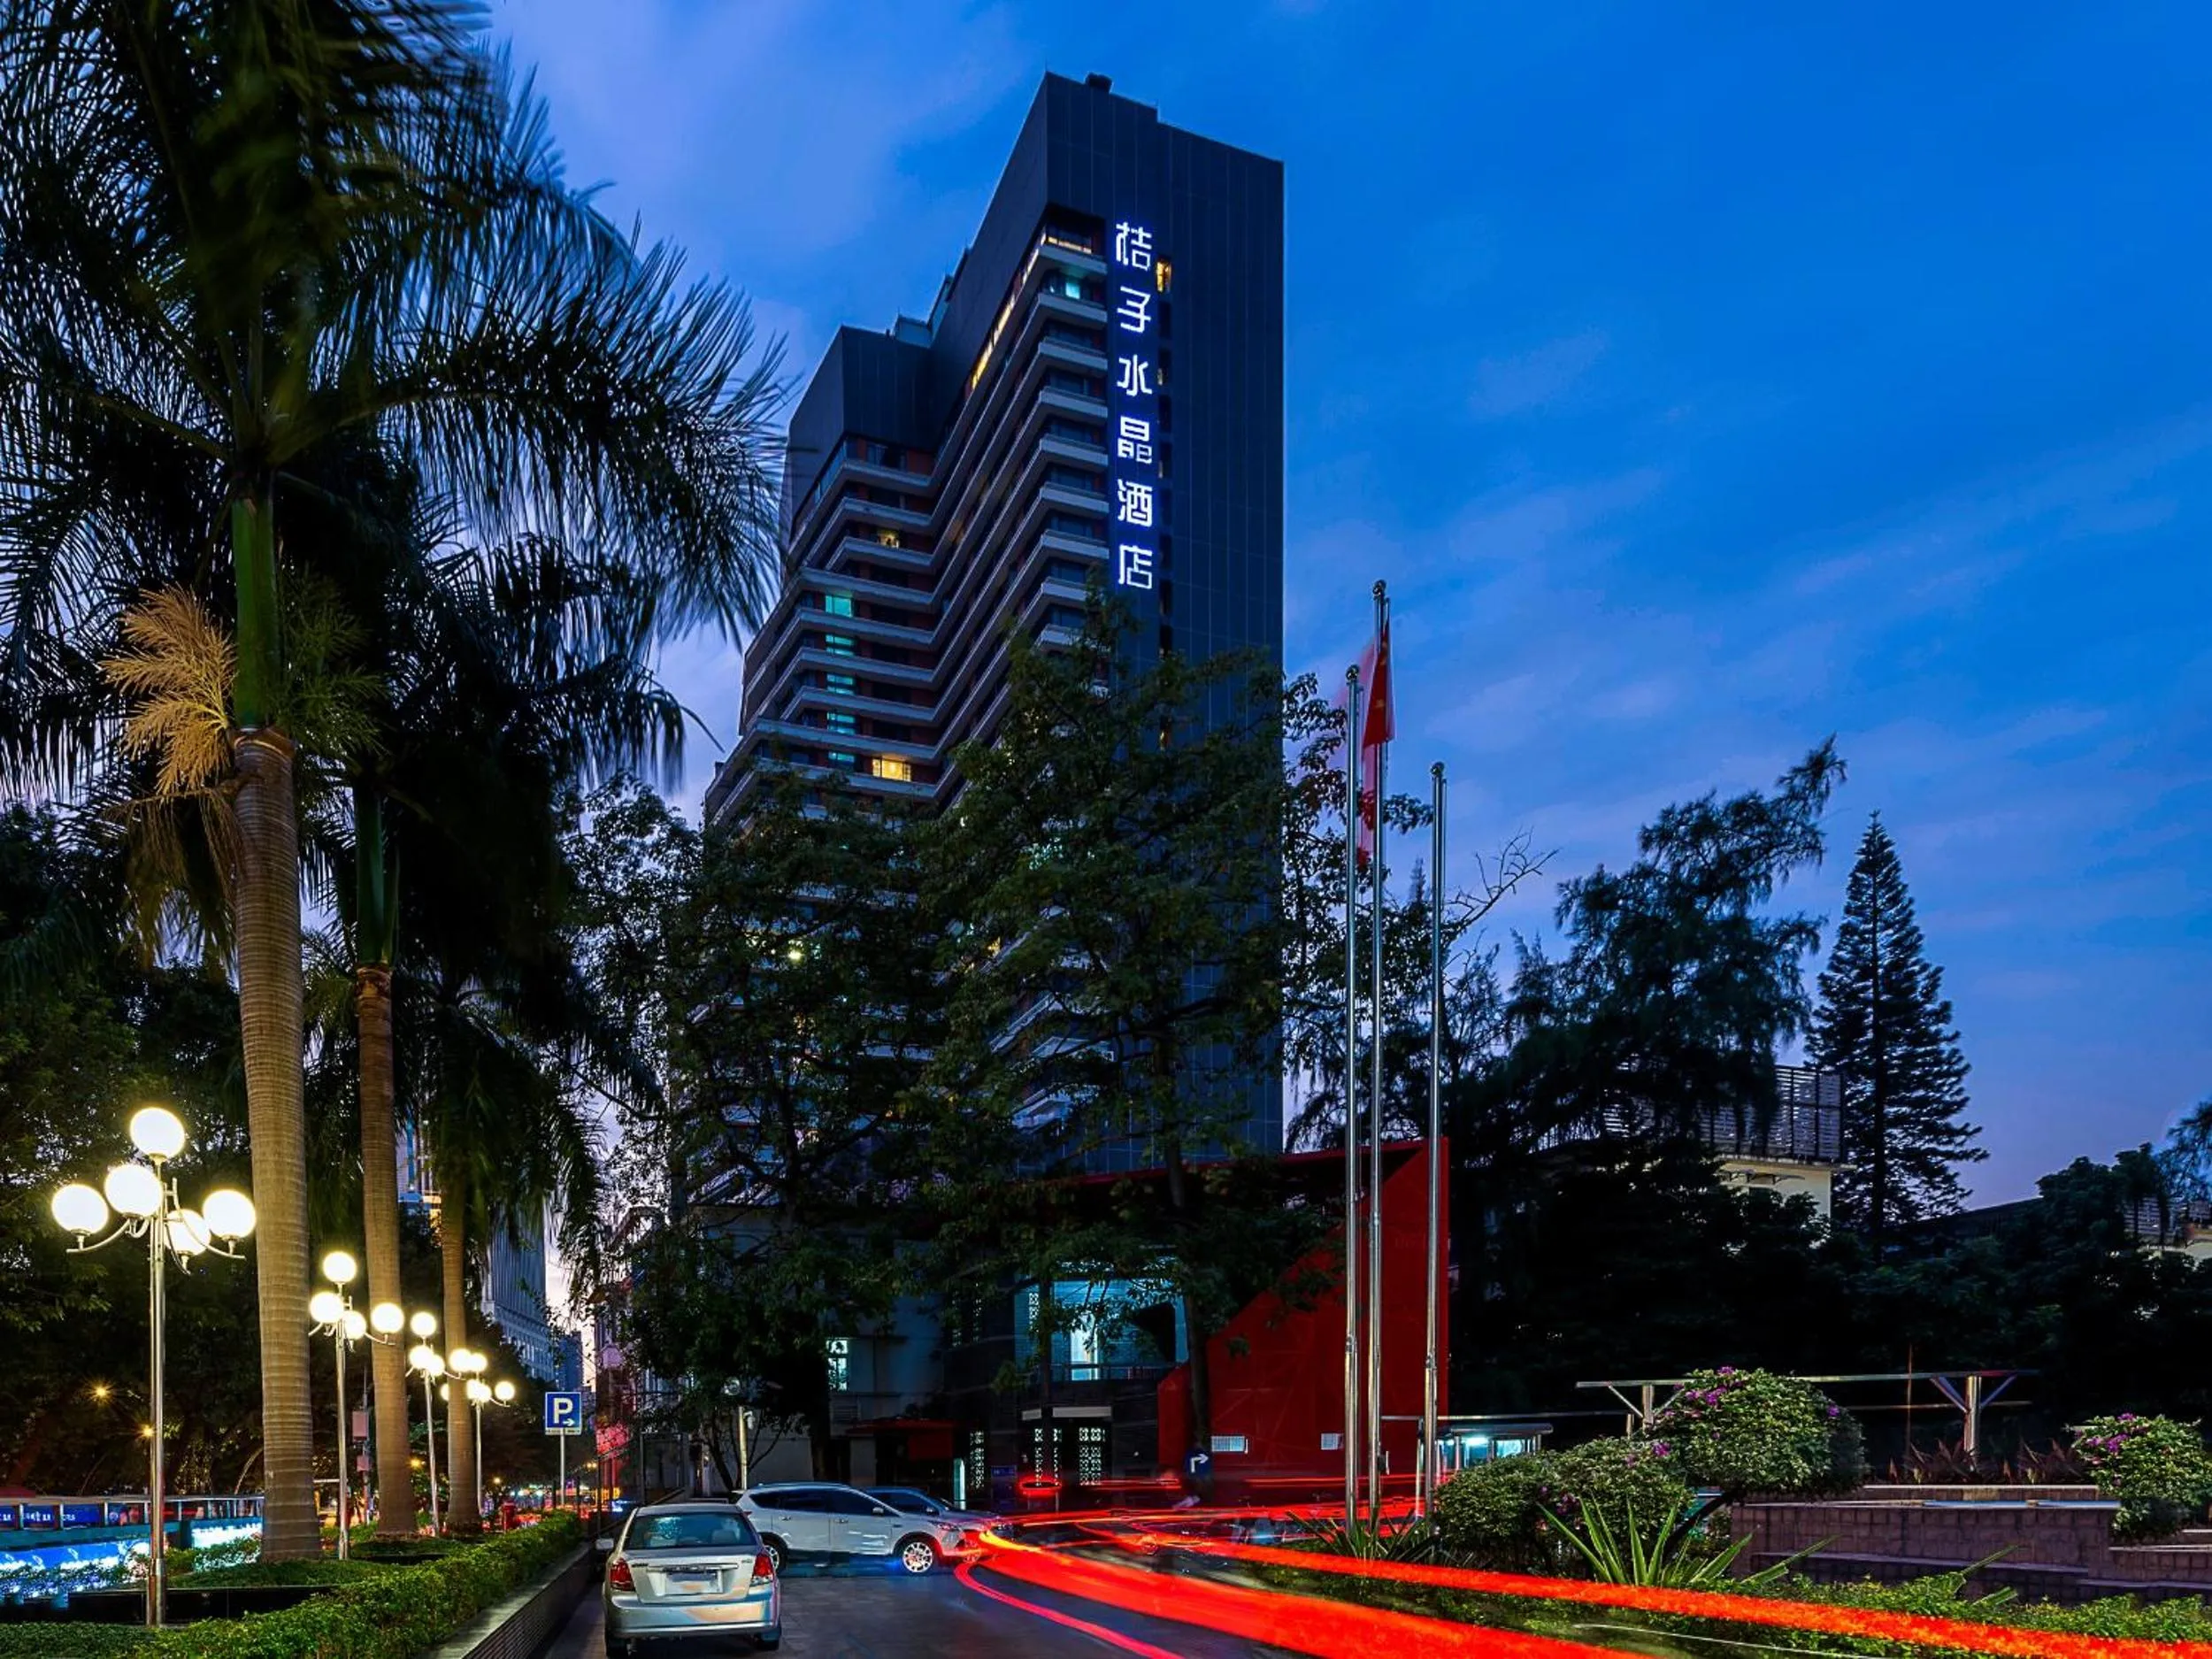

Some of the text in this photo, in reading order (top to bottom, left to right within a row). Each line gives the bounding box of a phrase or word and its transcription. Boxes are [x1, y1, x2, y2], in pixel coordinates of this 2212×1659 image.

[1115, 220, 1154, 590] 桔子水晶酒店
[554, 1397, 573, 1424] P
